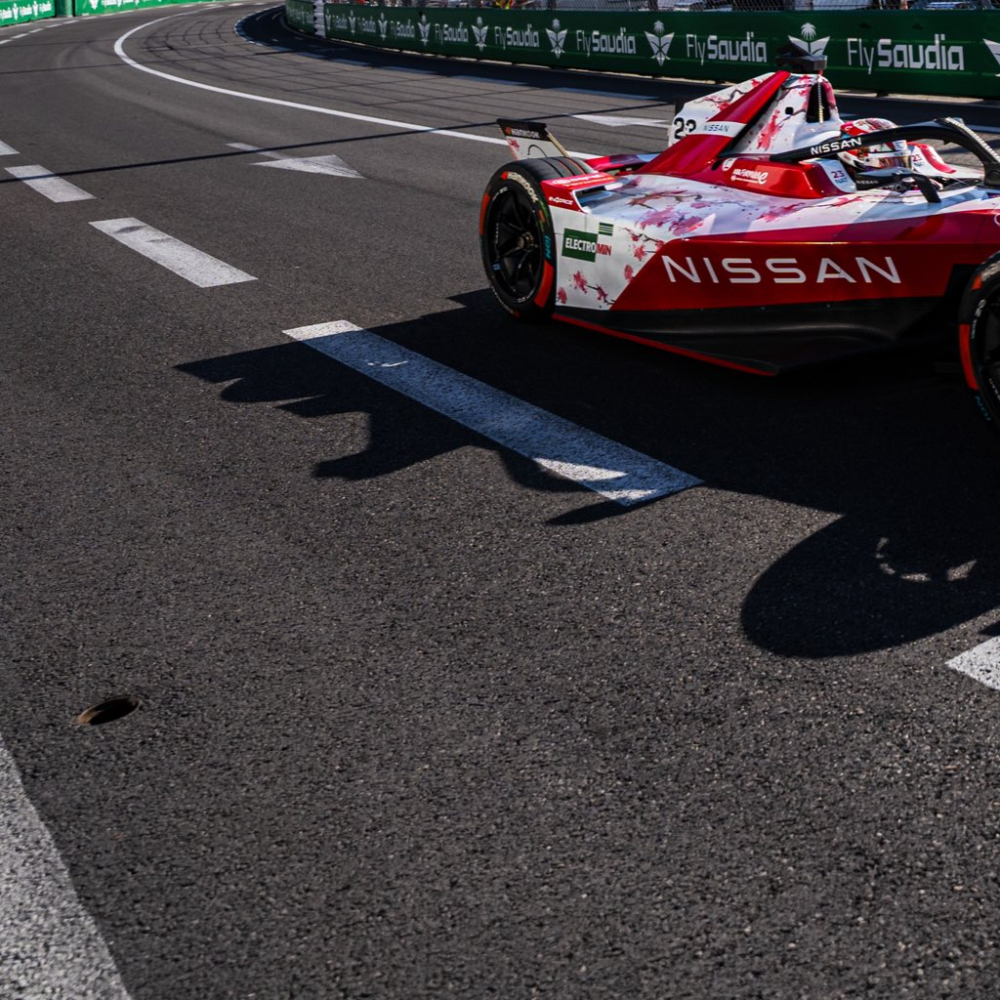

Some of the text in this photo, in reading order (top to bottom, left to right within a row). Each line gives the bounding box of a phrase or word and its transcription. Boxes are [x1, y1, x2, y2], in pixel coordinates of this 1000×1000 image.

[576, 27, 637, 57] FlySaudia
[686, 31, 767, 66] FlySaudia
[847, 33, 965, 75] FlySaudia
[810, 136, 863, 156] NISSAN
[831, 170, 845, 180] 23
[565, 238, 613, 257] ELECTROMIN
[661, 255, 902, 284] NISSAN
